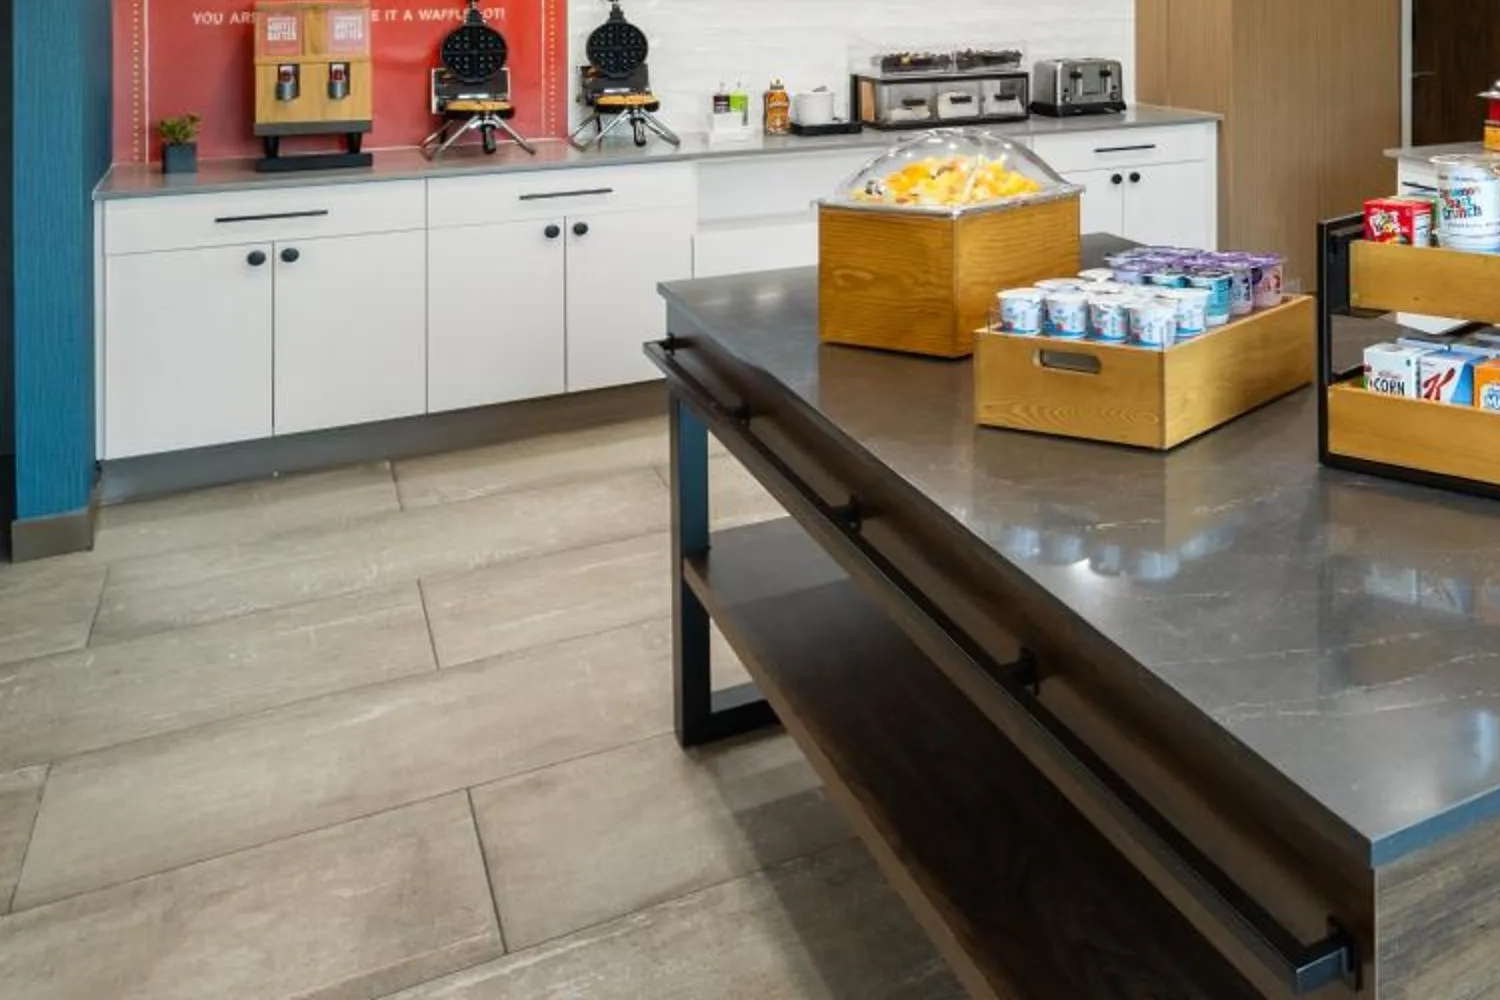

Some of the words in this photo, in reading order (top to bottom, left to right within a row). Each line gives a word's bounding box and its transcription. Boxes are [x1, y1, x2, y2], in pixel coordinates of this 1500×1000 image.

[192, 11, 224, 26] YOU
[385, 9, 398, 22] IT
[403, 9, 414, 22] A
[417, 7, 465, 21] WAFFL
[480, 7, 505, 20] OT!
[1374, 377, 1405, 397] CORN
[1423, 367, 1456, 401] K
